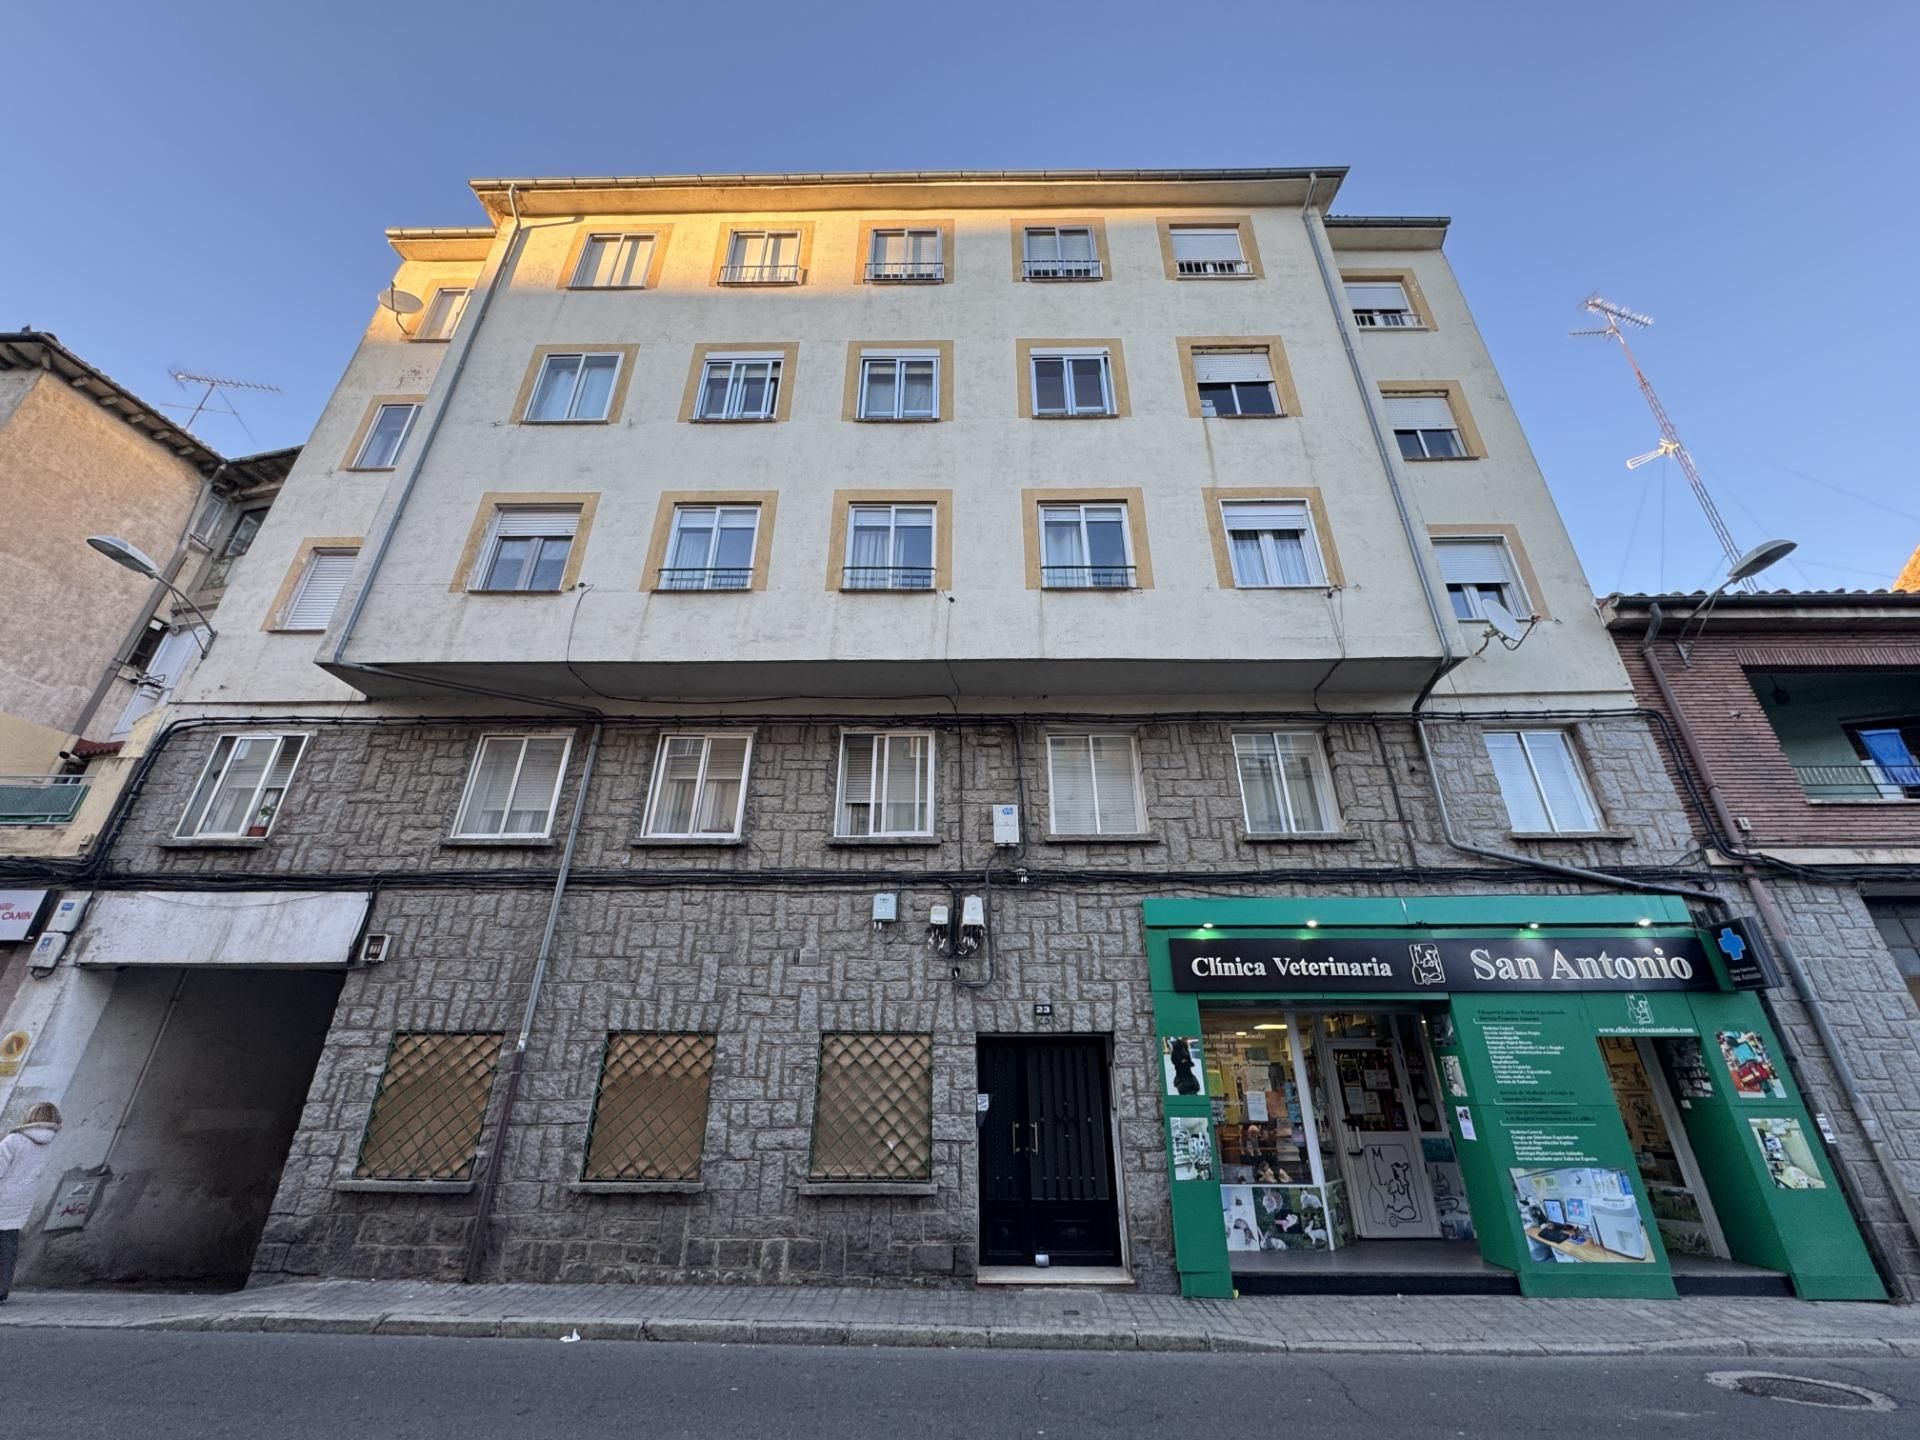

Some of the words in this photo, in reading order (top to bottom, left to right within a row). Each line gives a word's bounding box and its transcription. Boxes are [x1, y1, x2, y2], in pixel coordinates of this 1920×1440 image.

[1, 911, 33, 921] CANIN
[1191, 955, 1267, 977] Clínica
[1272, 957, 1393, 977] Veterinaria
[1470, 948, 1542, 981] San
[1551, 947, 1693, 981] Antonio
[1036, 1006, 1050, 1014] 23
